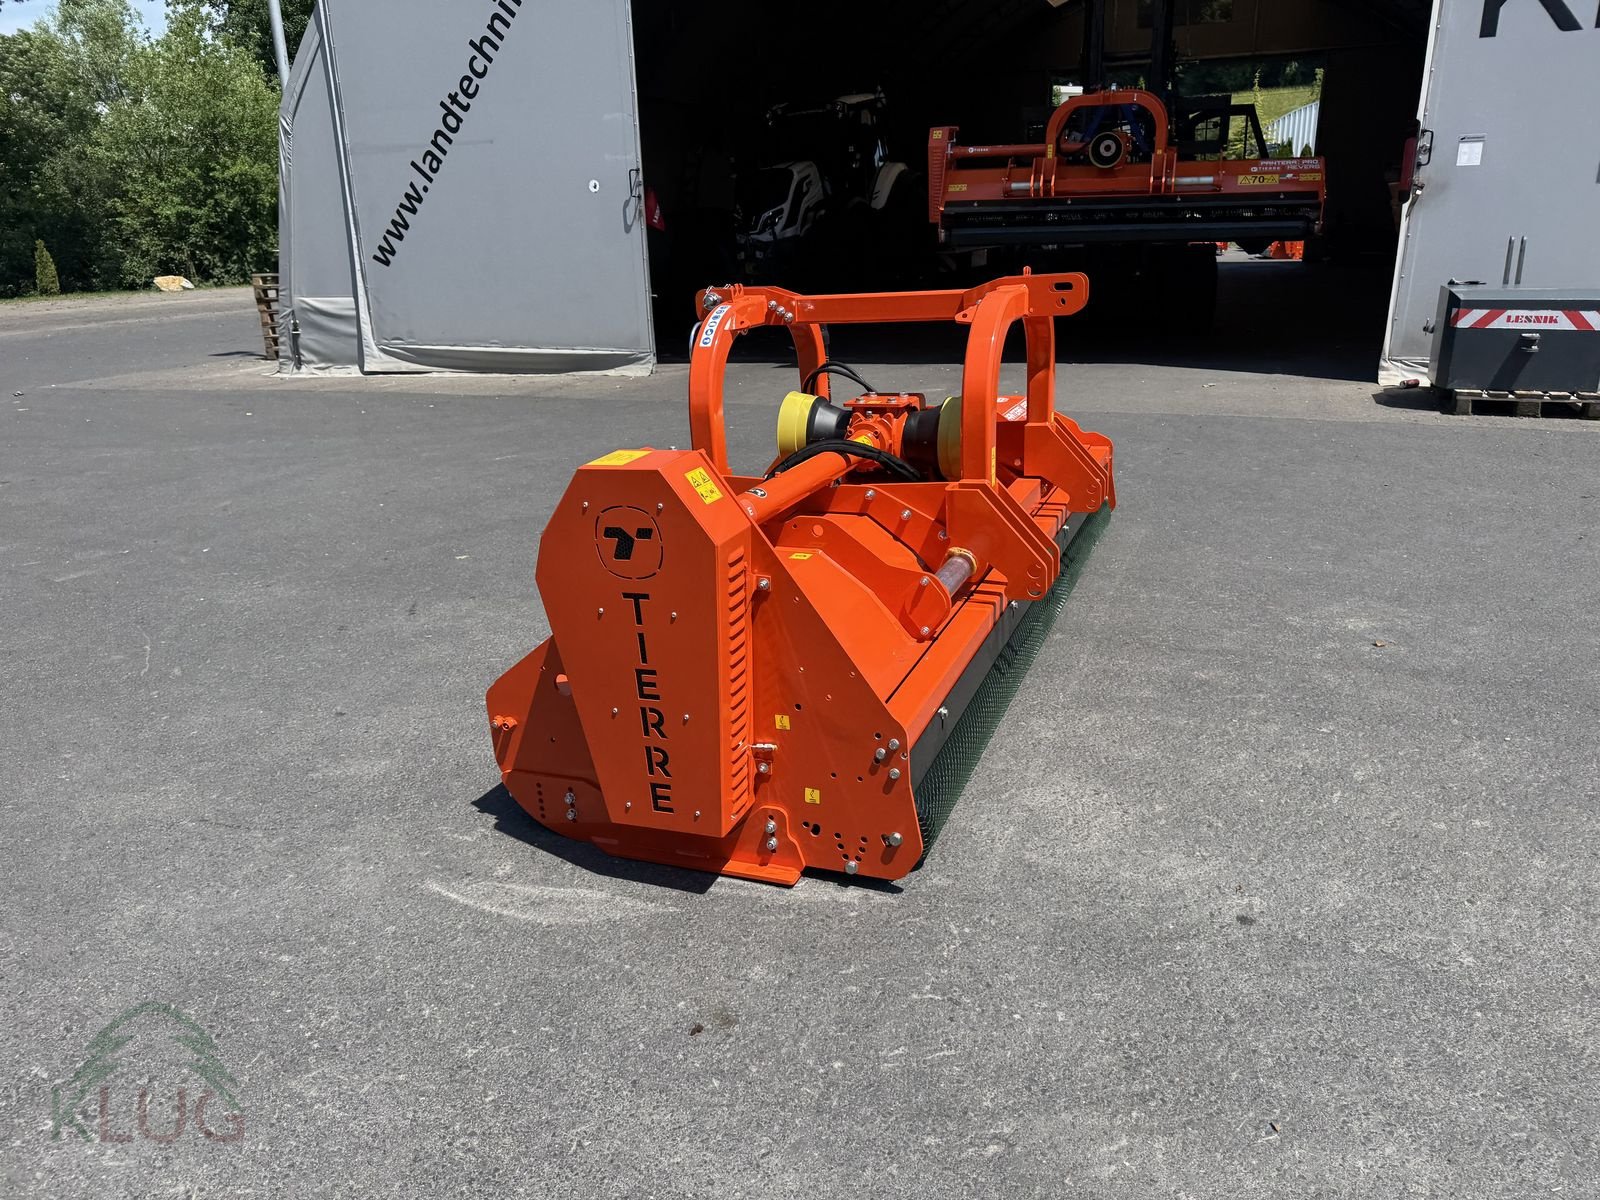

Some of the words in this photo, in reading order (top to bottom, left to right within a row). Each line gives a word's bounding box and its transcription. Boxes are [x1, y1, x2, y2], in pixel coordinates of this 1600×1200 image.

[372, 0, 522, 267] www.landtechni
[1251, 175, 1265, 184] 70
[1506, 315, 1559, 324] LESNIK
[622, 592, 675, 815] TIERRE
